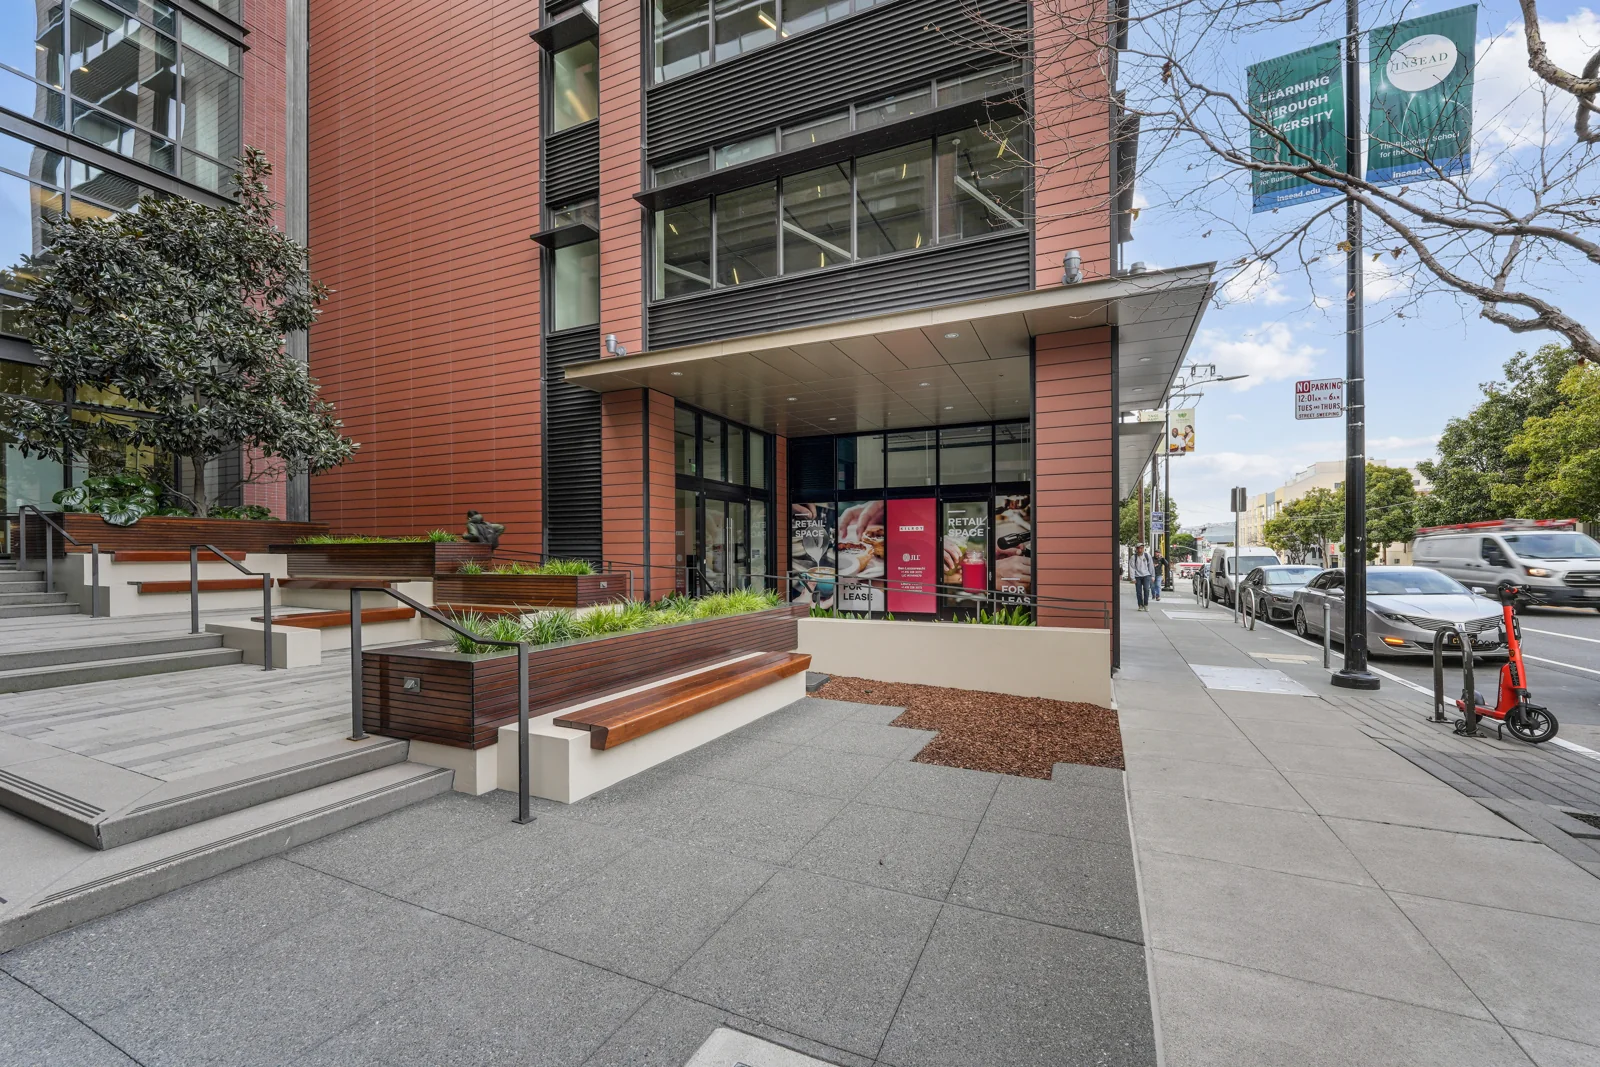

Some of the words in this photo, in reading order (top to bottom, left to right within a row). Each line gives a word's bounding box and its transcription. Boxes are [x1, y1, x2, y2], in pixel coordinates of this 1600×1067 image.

[1395, 52, 1448, 70] INSEAD
[1259, 75, 1330, 103] LEARNING
[1260, 93, 1328, 119] THROUGH
[1260, 109, 1334, 138] DVERSITY
[1432, 131, 1460, 141] School
[1277, 187, 1321, 202] insead.edu
[1297, 382, 1309, 392] NO
[1311, 382, 1341, 391] PARKING
[795, 519, 826, 528] RETAIL
[947, 517, 986, 526] RETAIL
[795, 529, 825, 538] SPACE
[947, 528, 984, 537] SPACE
[843, 582, 862, 591] FOR
[1001, 585, 1025, 594] FOR
[843, 593, 873, 601] LEASE
